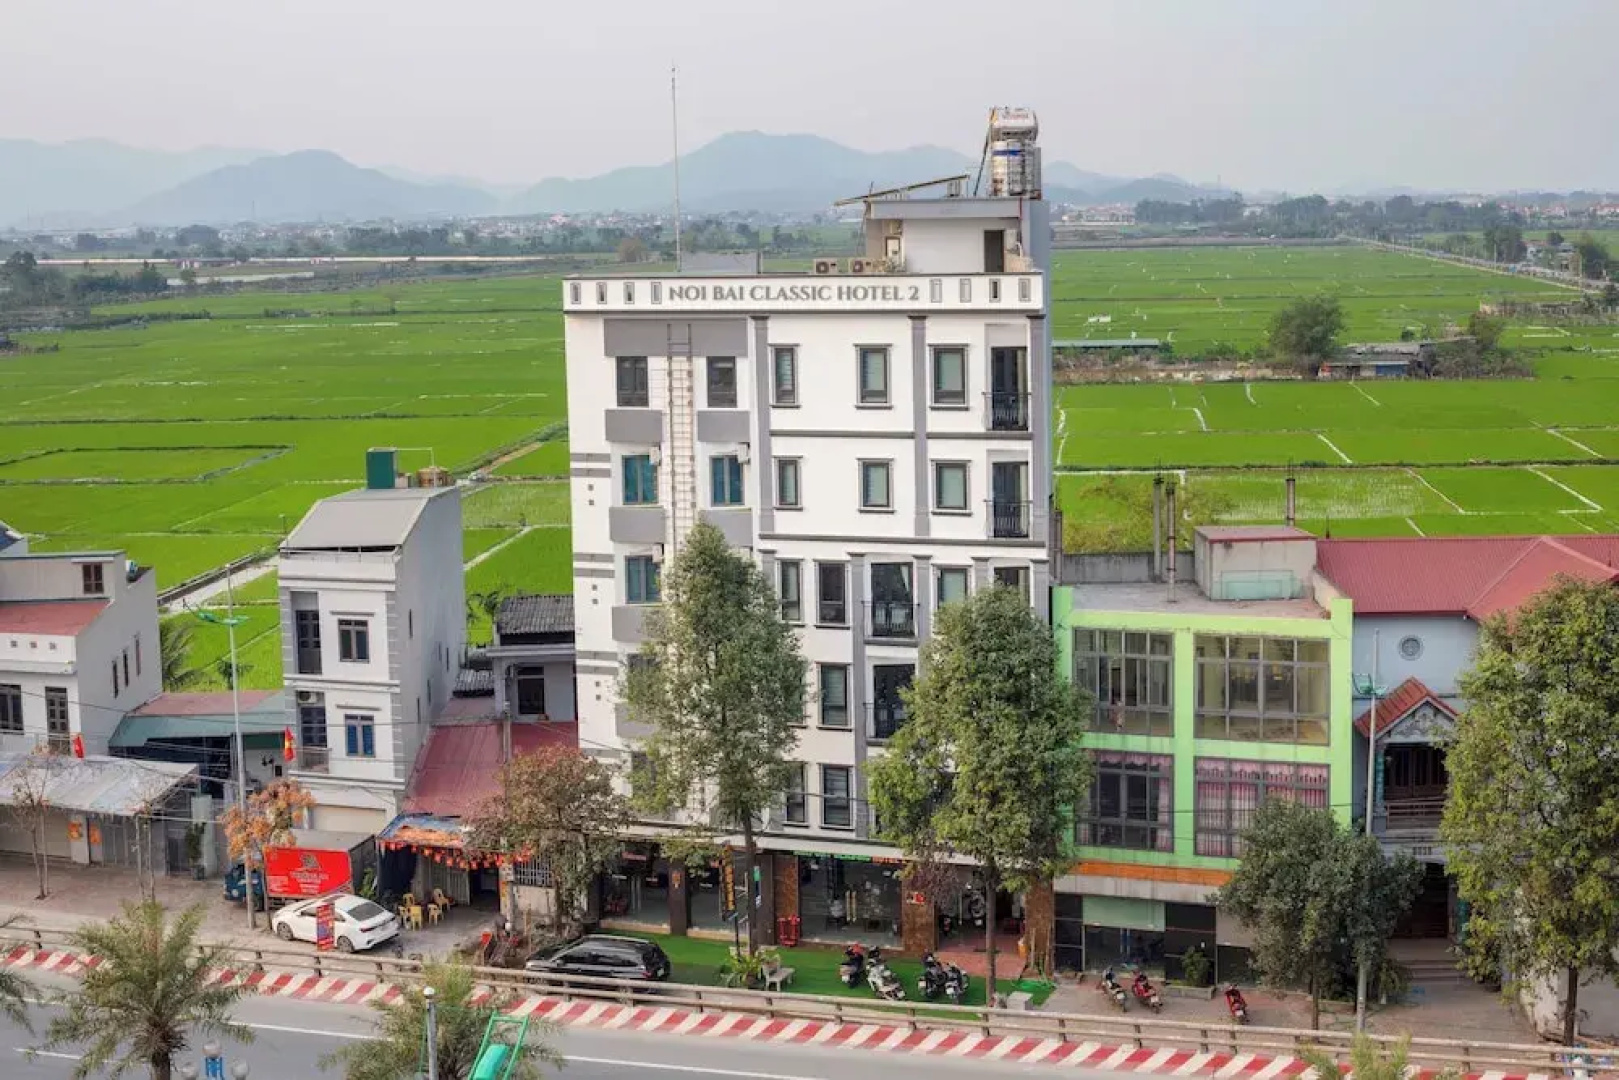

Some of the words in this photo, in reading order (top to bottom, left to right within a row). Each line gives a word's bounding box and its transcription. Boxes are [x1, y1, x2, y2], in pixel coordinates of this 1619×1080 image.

[669, 285, 706, 301] NOI
[712, 285, 744, 301] BAI
[749, 285, 831, 301] CLASSIC
[837, 285, 904, 301] HOTEL
[908, 285, 919, 301] 2
